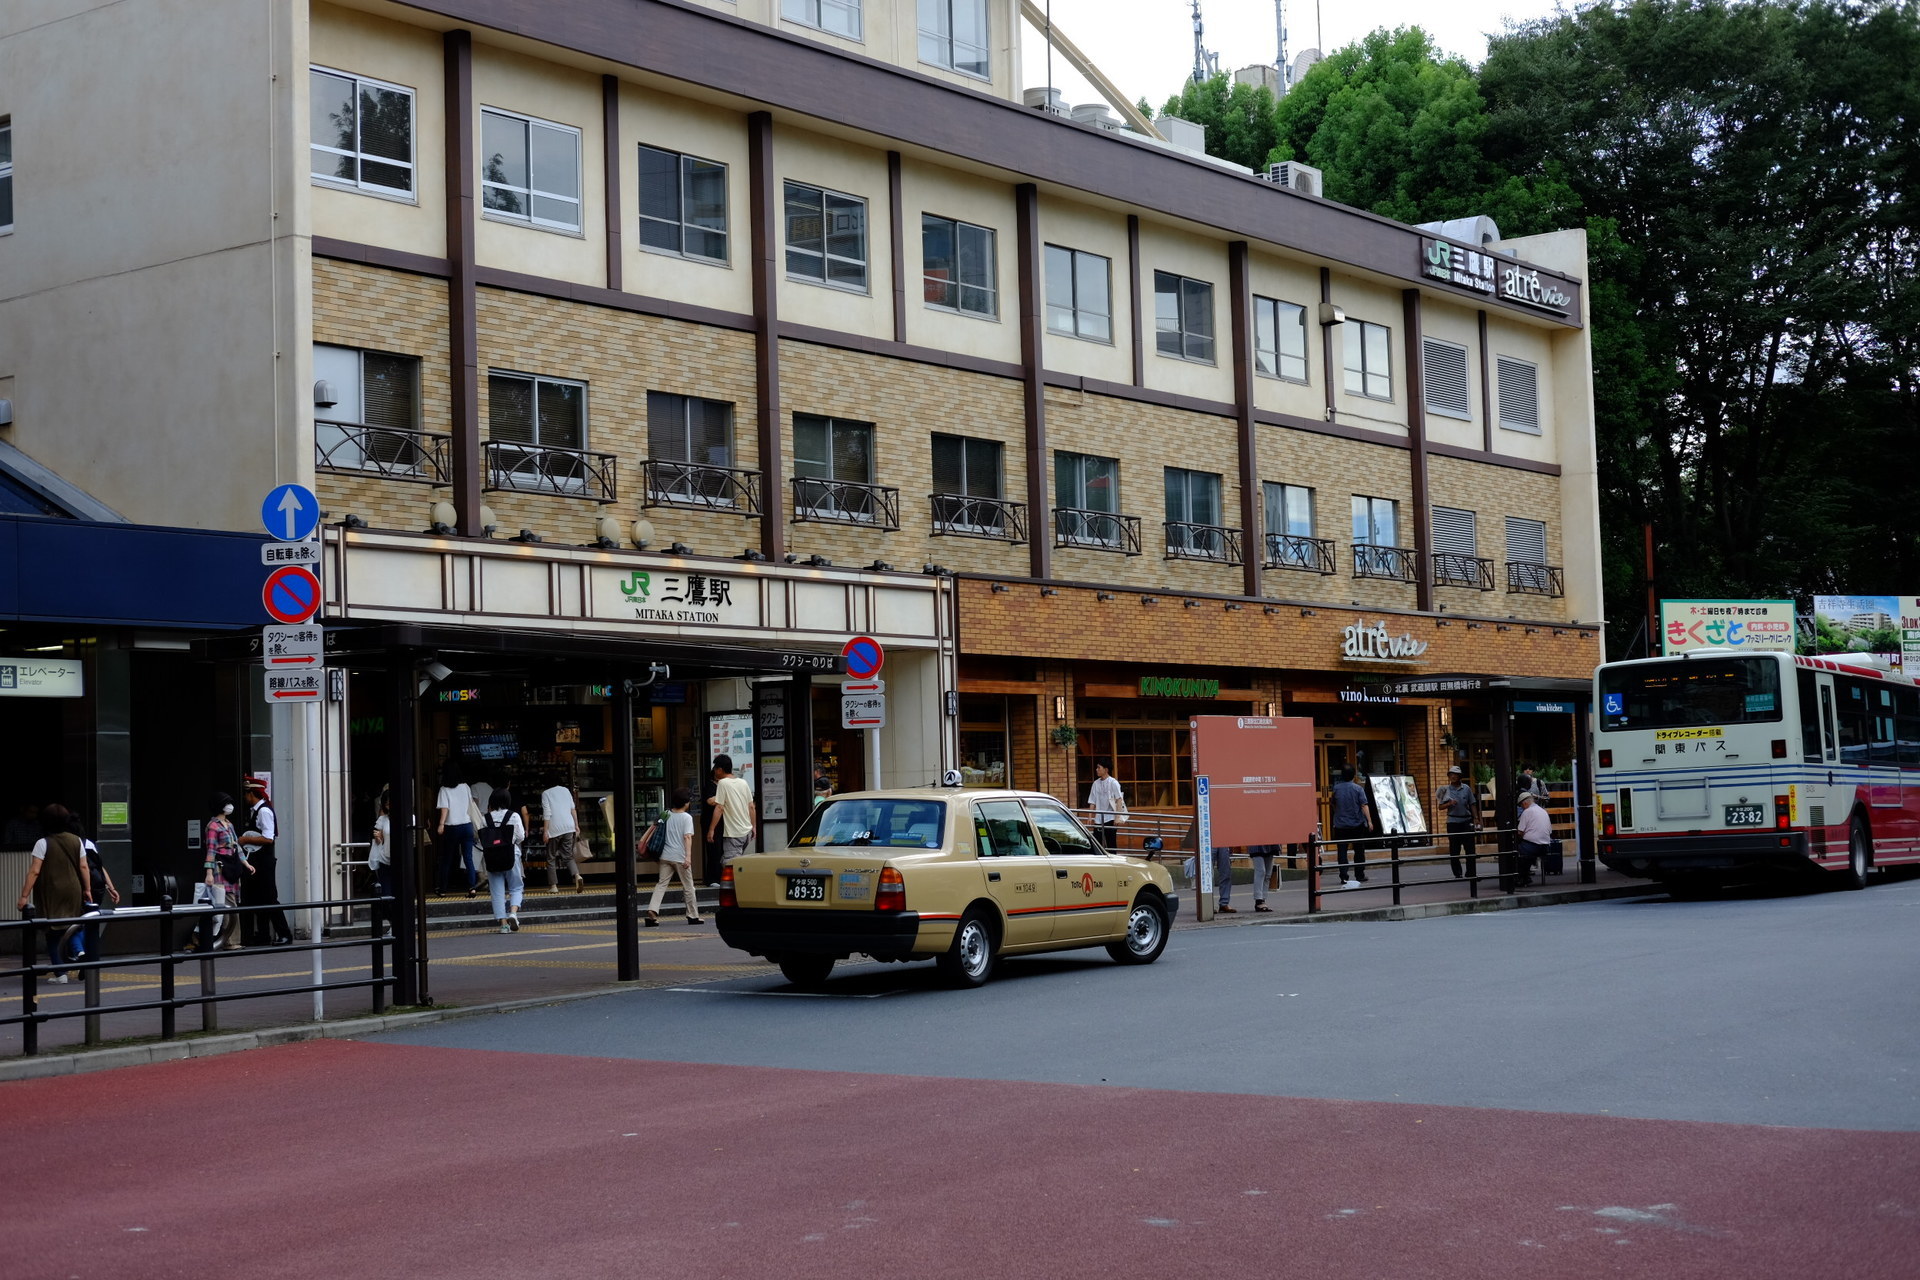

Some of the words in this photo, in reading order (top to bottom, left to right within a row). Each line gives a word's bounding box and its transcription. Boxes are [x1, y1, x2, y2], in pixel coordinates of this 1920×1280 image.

[1428, 240, 1451, 268] JR
[1454, 247, 1494, 279] 三鷹駅
[1454, 271, 1473, 287] Mitaka
[1475, 278, 1495, 293] Station
[1505, 265, 1540, 303] atré
[1540, 286, 1570, 306] vie
[266, 547, 316, 561] 自転車を除く
[620, 571, 650, 596] JR
[660, 574, 732, 607] 三鷹駅
[635, 608, 674, 620] MITAKA
[677, 611, 719, 623] STATION
[1902, 616, 1920, 629] 3LDK
[267, 631, 318, 642] タクシーの客待ち
[1345, 618, 1389, 658] atré
[1389, 633, 1428, 658] vie
[1667, 619, 1745, 645] きくざと
[1745, 634, 1792, 644] ファミリークリニック
[268, 644, 288, 655] を除く
[783, 655, 833, 669] タクシーのりば
[20, 666, 76, 678] エレベーター
[20, 678, 43, 686] Elevator
[269, 676, 319, 689] 路線バスを除く
[1141, 676, 1219, 698] KINOKUNIYA
[439, 688, 478, 702] KIOSK
[1340, 686, 1361, 703] vino
[845, 700, 882, 709] タクシーの客待ち
[761, 712, 784, 724] タクシー
[846, 710, 859, 718] を除く
[762, 727, 784, 738] のりば
[1655, 740, 1726, 755] 関東バス
[1731, 811, 1762, 824] 23-82
[852, 831, 870, 839] E48
[807, 878, 817, 886] 500
[794, 886, 824, 899] 89-33
